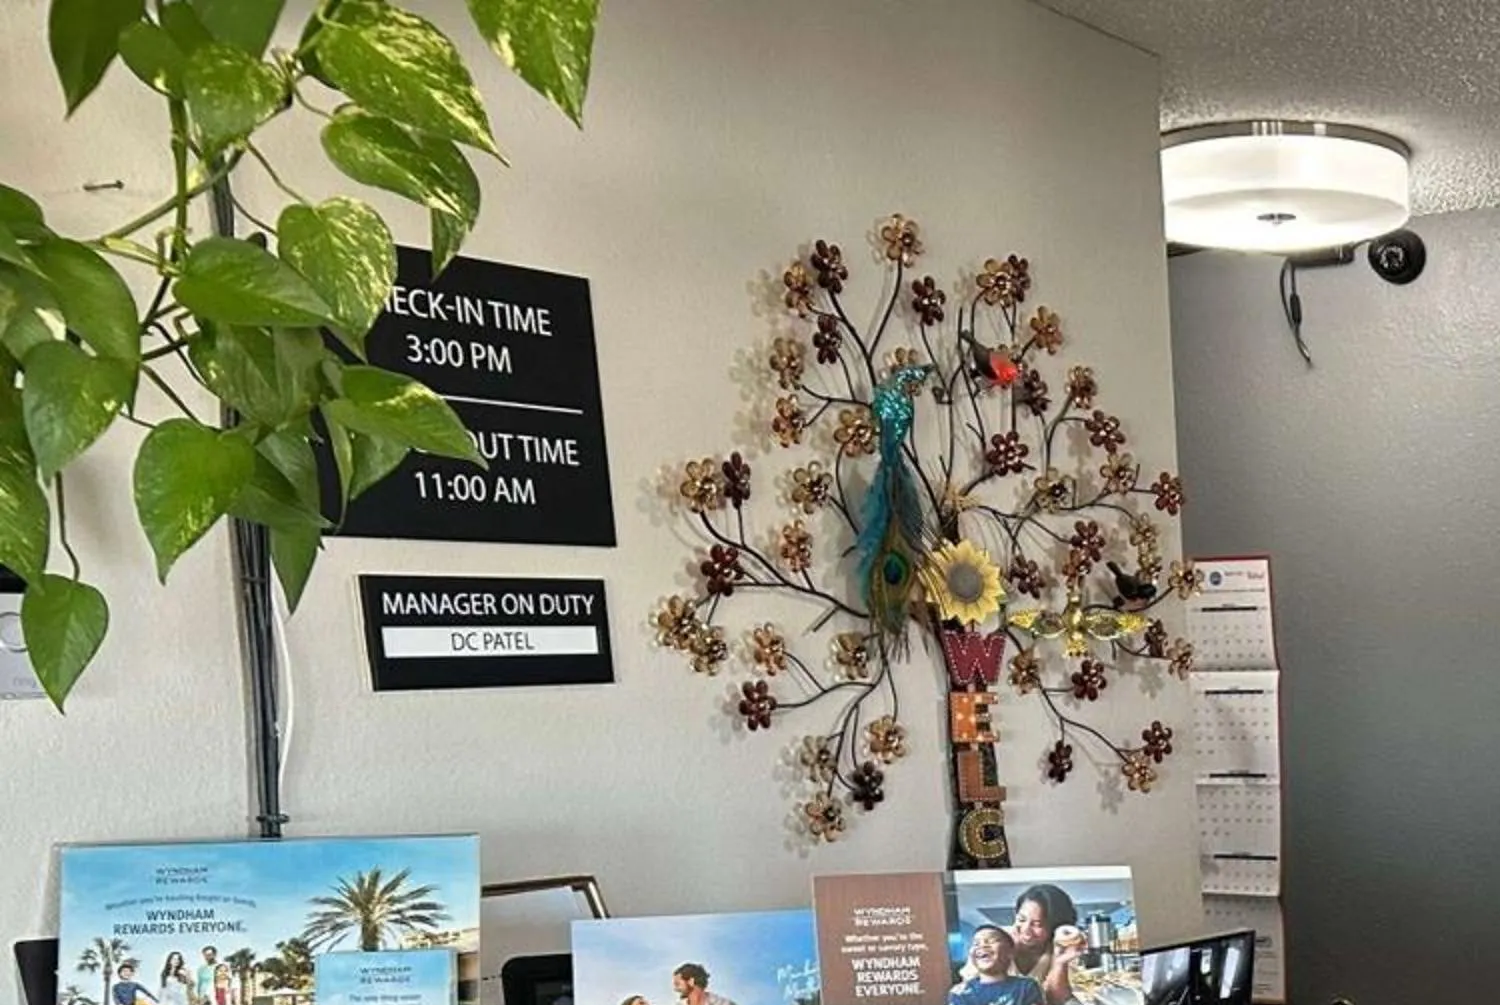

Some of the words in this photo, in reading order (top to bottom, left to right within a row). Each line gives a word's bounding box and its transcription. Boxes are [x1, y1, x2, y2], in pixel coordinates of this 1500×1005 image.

[384, 285, 484, 327] ECK-IN
[489, 300, 553, 337] TIME
[405, 334, 463, 368] 3:00
[471, 342, 513, 374] PM
[518, 435, 581, 467] TIME
[415, 471, 486, 502] 11:00
[494, 477, 537, 505] AM
[381, 592, 497, 616] MANAGER
[501, 592, 534, 616] ON
[540, 594, 595, 616] DUTY
[450, 631, 479, 651] DC
[483, 631, 536, 651] PATEL
[944, 629, 1007, 859] WELC
[146, 908, 215, 921] WYNDHAM
[113, 923, 175, 935] REWARDS
[851, 956, 921, 971] WYNDHAM
[857, 969, 919, 983] REWARDS
